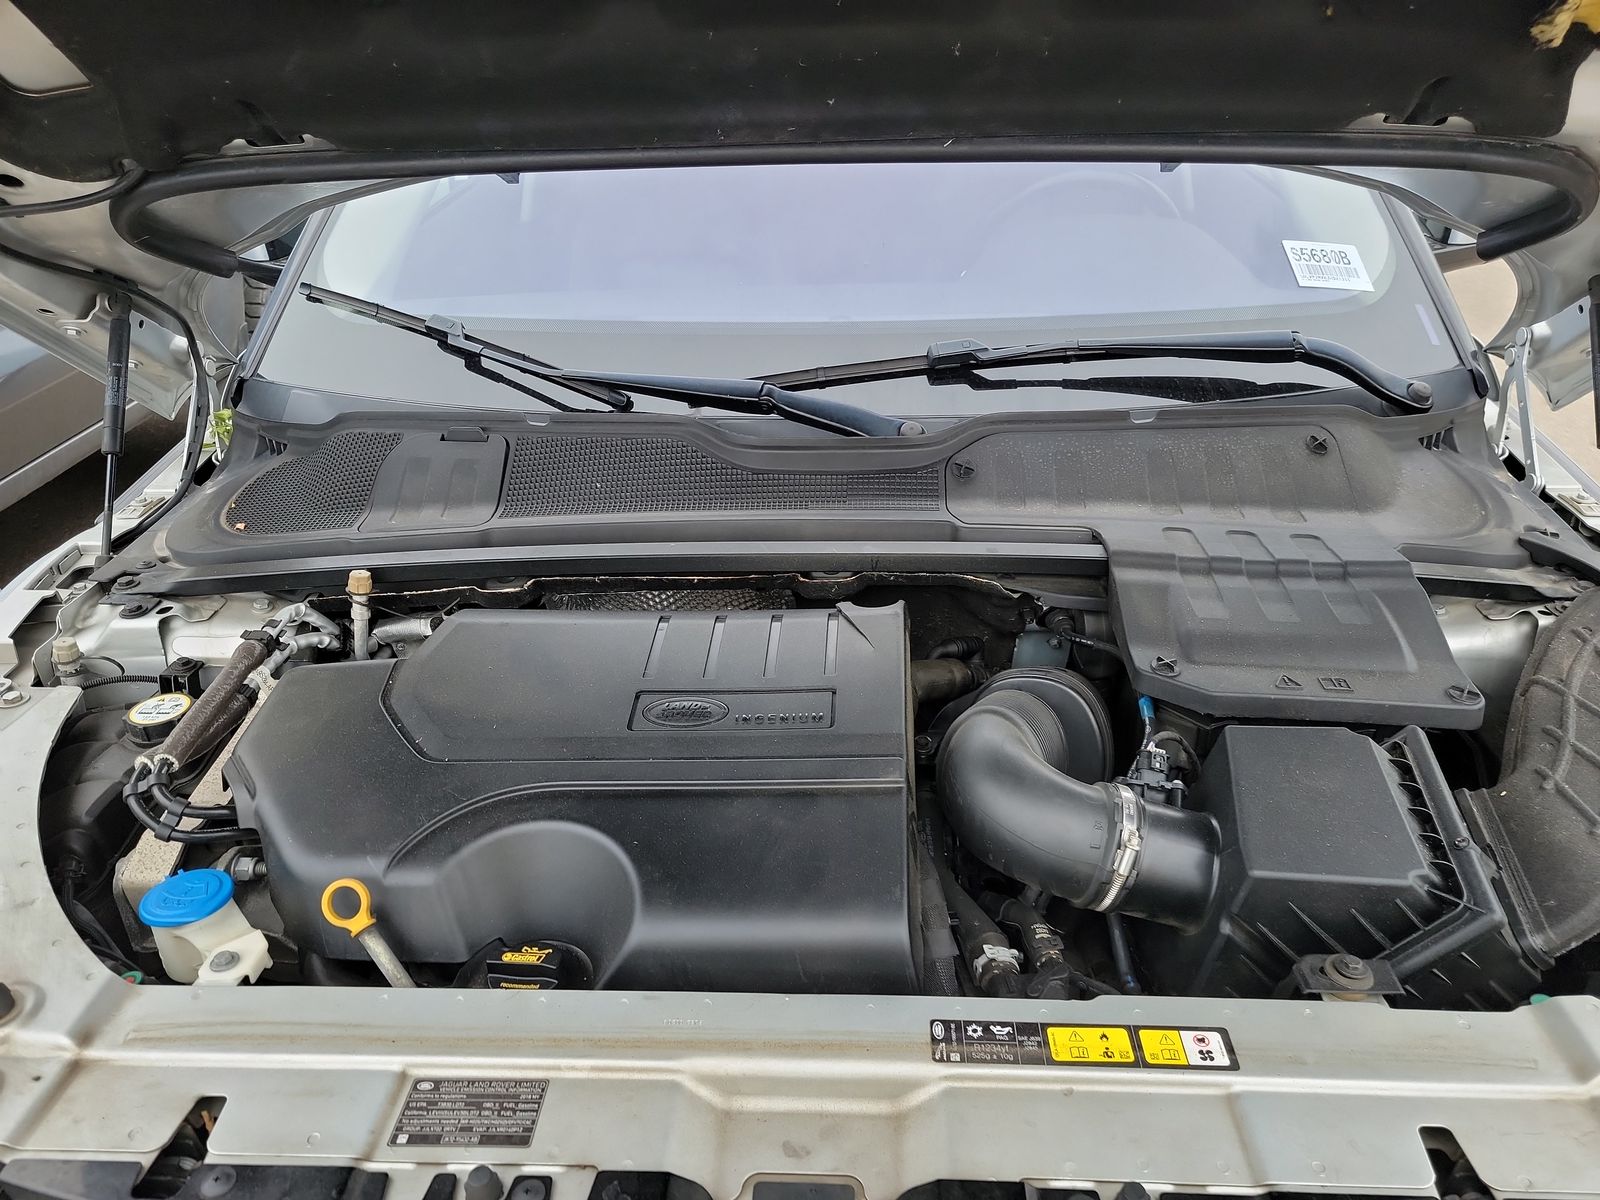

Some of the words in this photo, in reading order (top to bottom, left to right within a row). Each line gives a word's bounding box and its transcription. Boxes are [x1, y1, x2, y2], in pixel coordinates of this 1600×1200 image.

[1290, 247, 1351, 265] S5680B
[735, 712, 824, 724] INGENIUM
[511, 954, 539, 962] Castrol
[973, 1043, 1009, 1052] R1234yf
[971, 1051, 990, 1060] 525g
[1000, 1052, 1013, 1061] 10g
[516, 1081, 546, 1089] LIMITED
